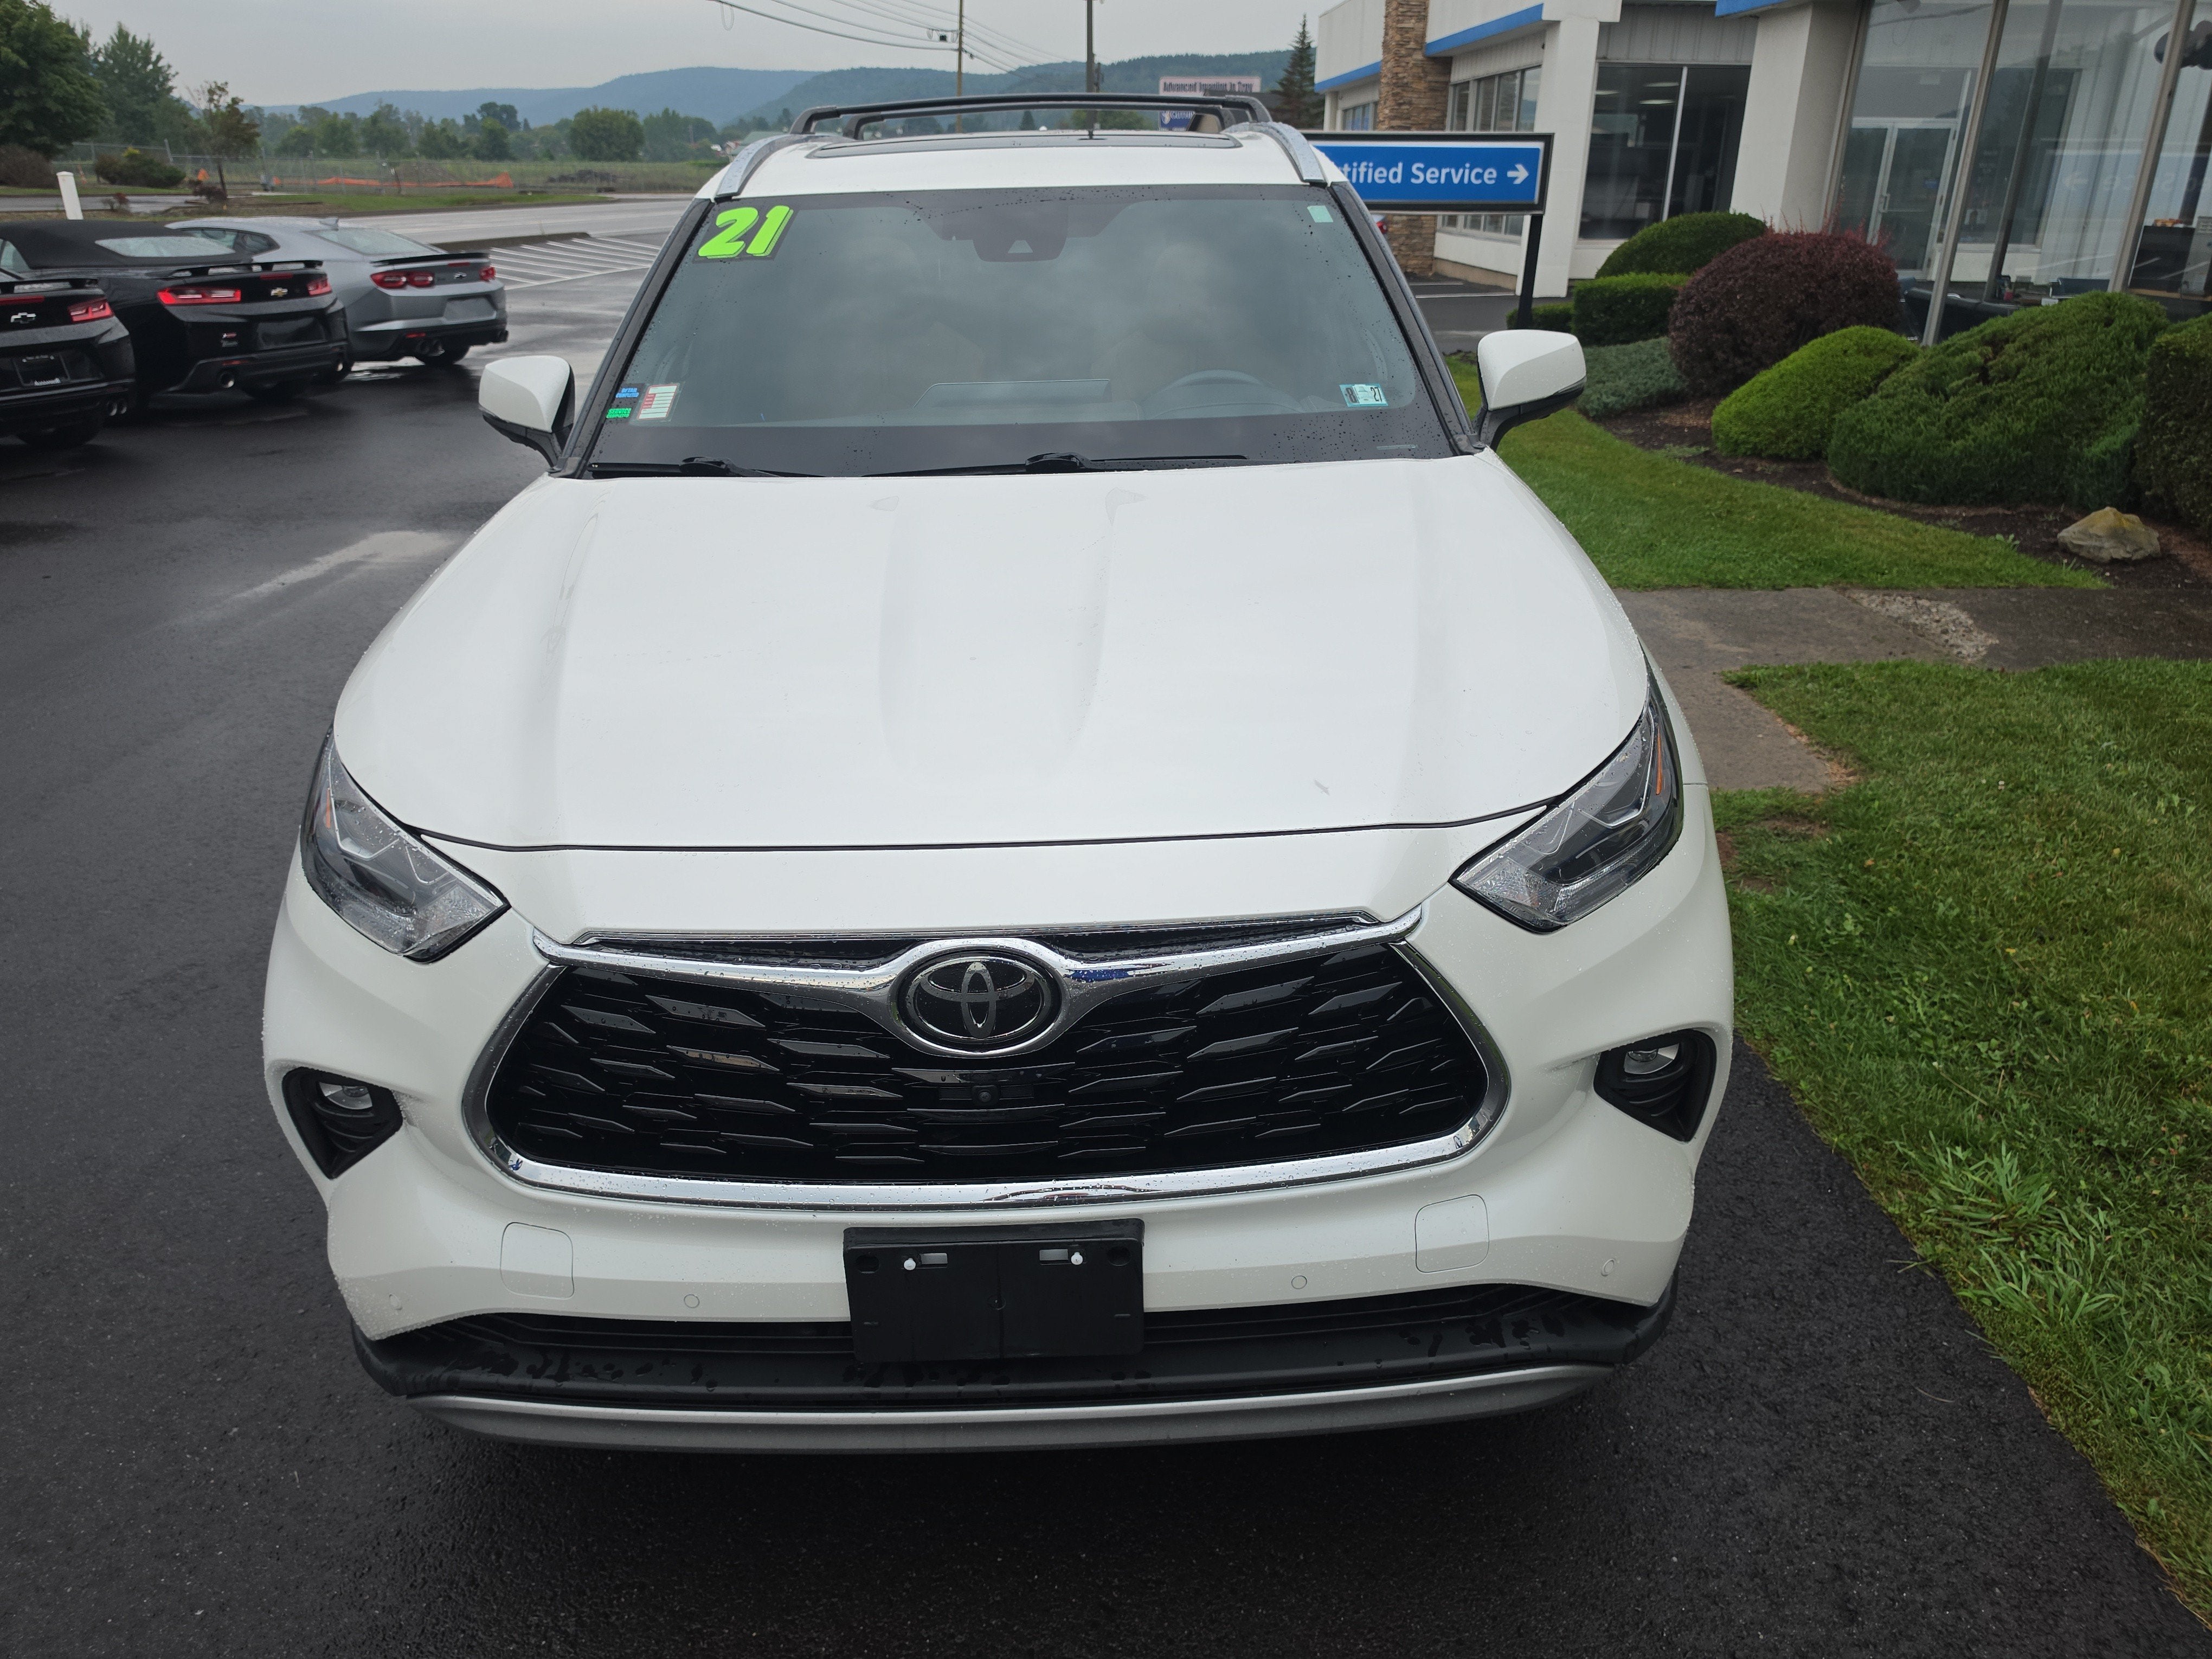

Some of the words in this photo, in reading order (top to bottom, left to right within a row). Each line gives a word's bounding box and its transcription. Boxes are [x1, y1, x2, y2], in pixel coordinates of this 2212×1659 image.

[1340, 162, 1403, 184] tified
[1411, 163, 1497, 184] Service
[698, 205, 794, 259] 21
